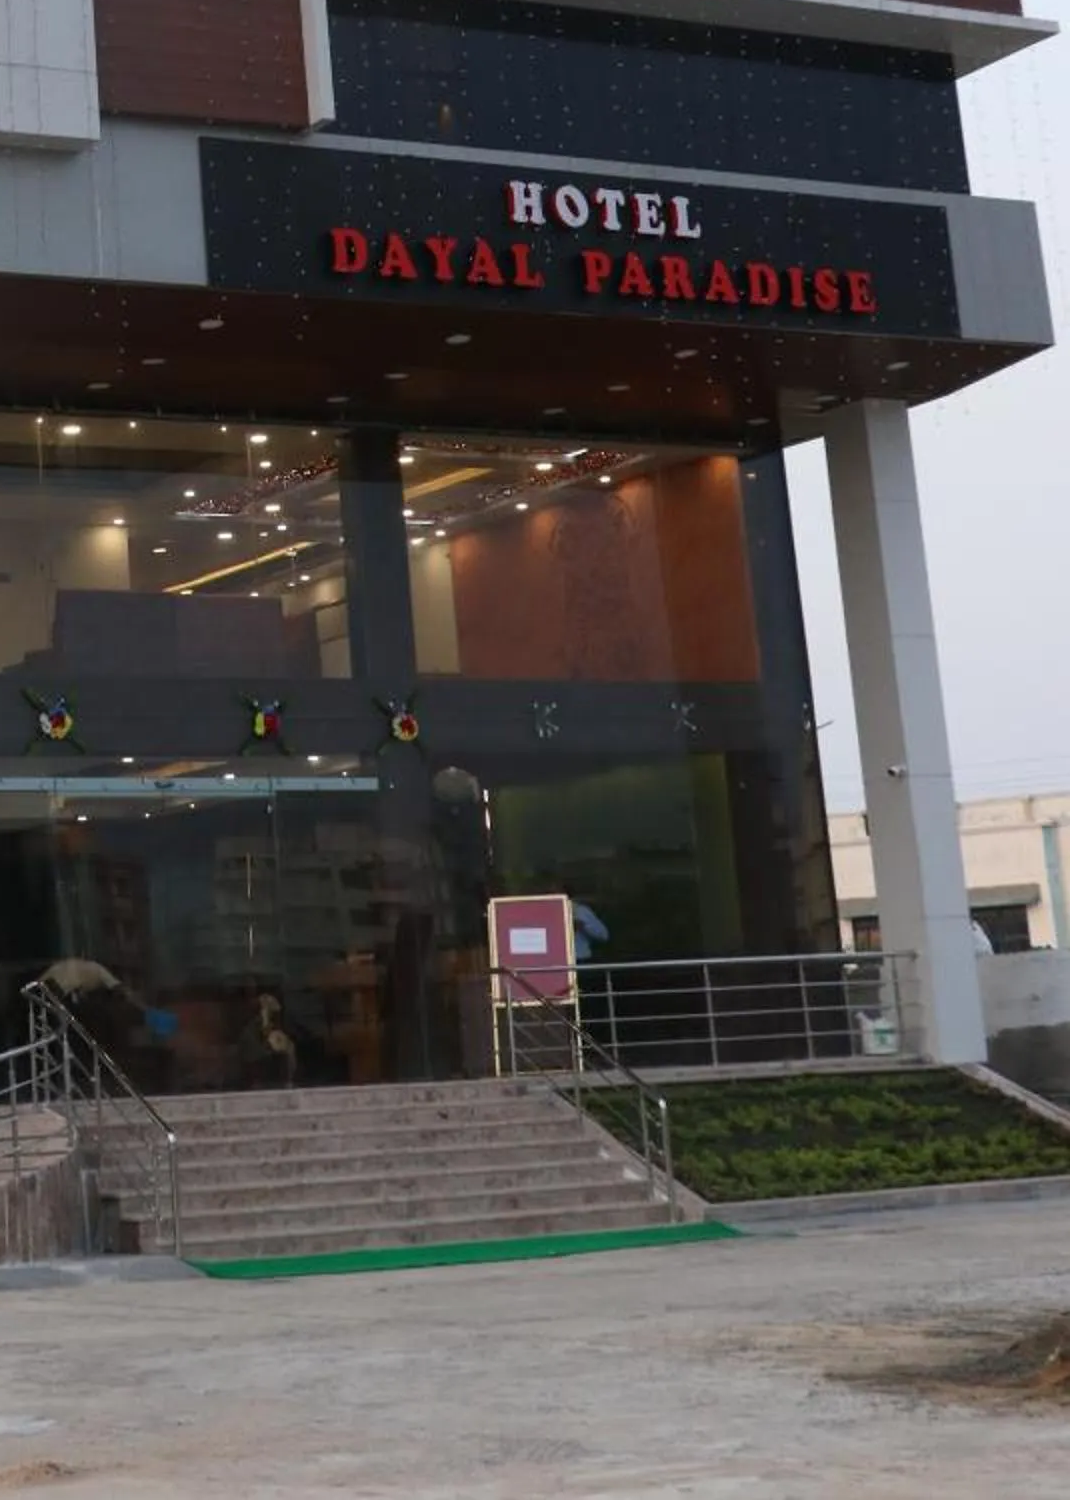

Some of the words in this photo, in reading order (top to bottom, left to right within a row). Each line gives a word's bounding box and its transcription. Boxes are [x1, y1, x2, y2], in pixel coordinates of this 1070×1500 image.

[507, 180, 702, 239] HOTEL
[330, 228, 544, 288] DAYAL
[583, 251, 878, 315] PARADISE
